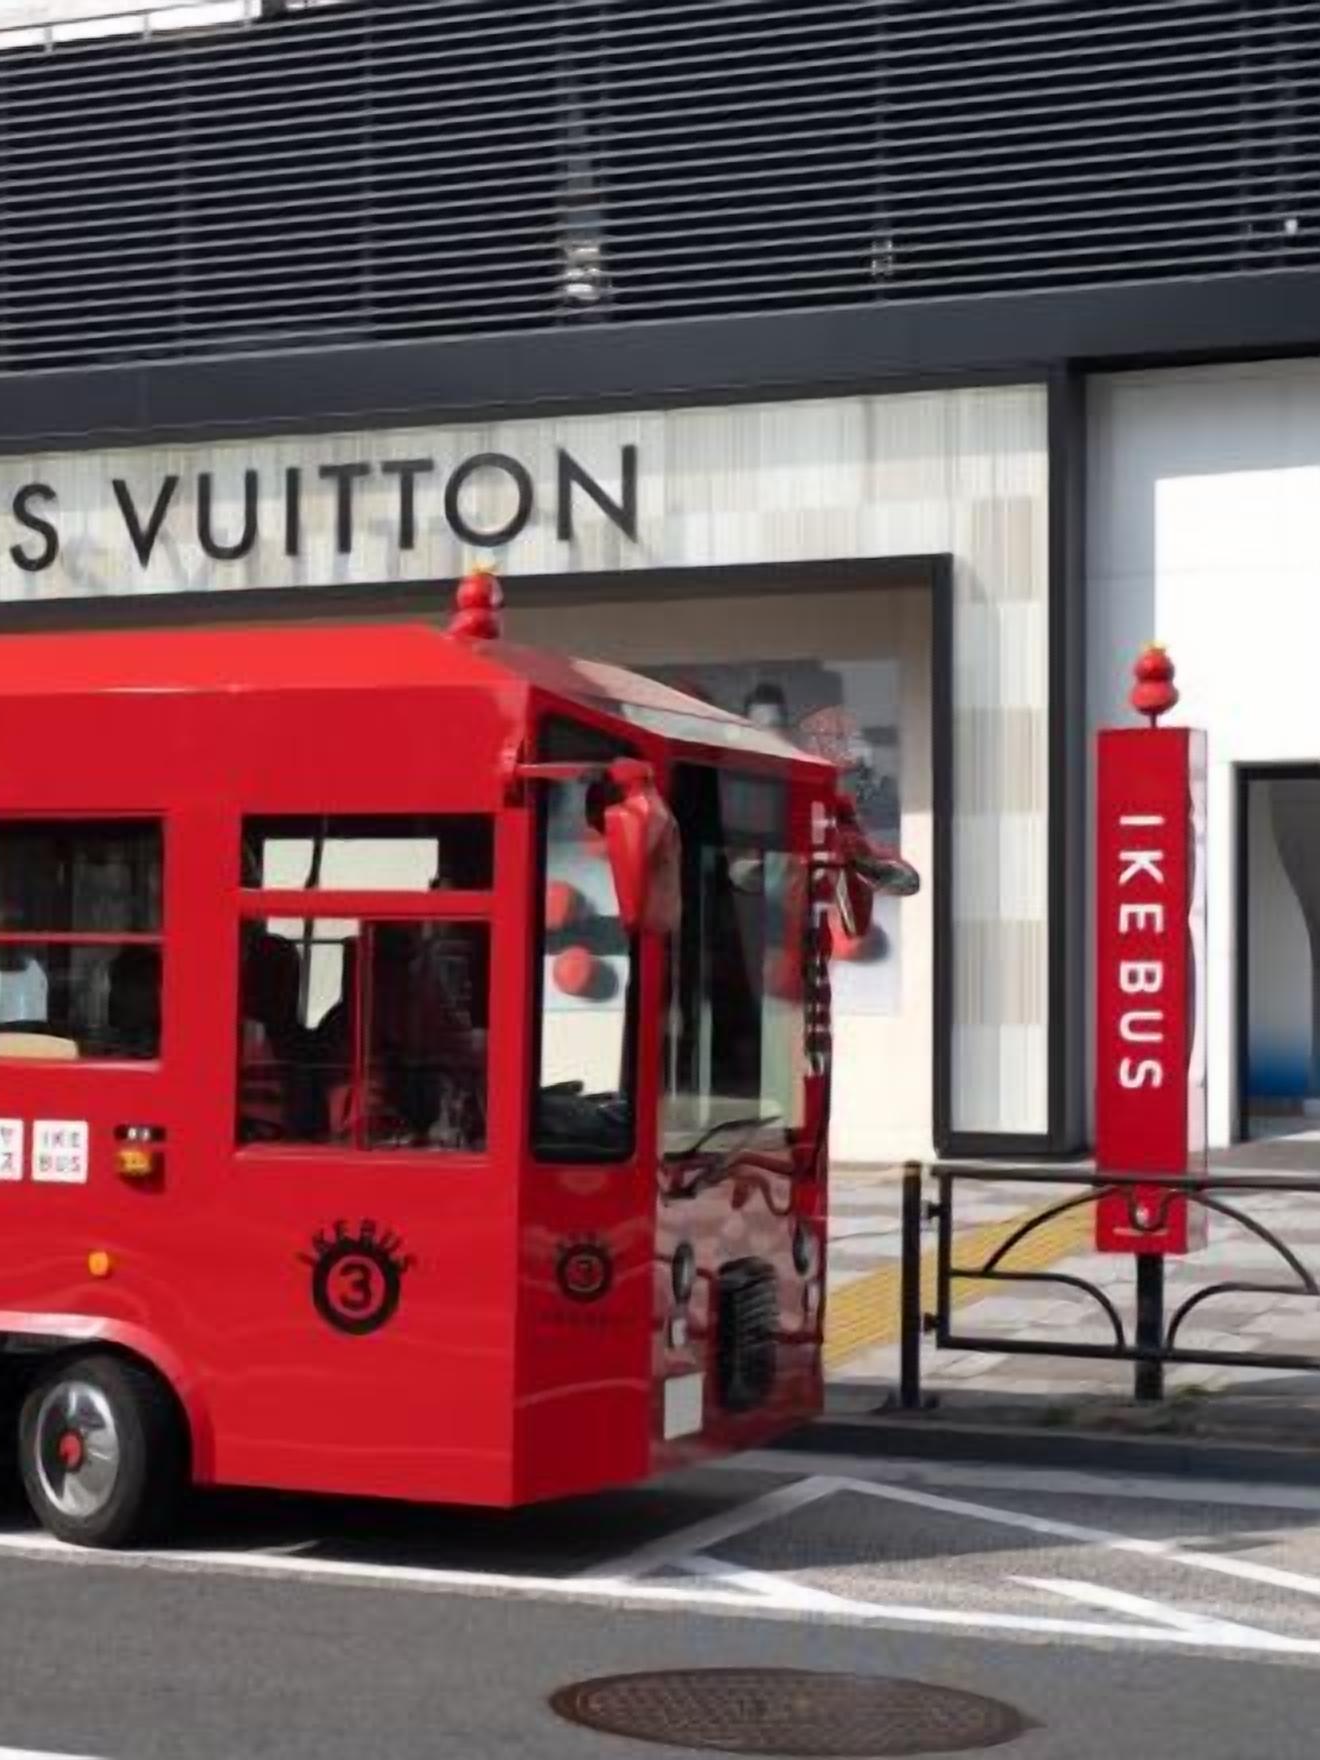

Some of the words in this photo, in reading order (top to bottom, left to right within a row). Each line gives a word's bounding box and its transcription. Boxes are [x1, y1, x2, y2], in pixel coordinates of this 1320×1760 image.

[111, 444, 640, 567] VUITTON
[1118, 814, 1165, 1089] IKEBUS
[339, 1263, 373, 1311] 3
